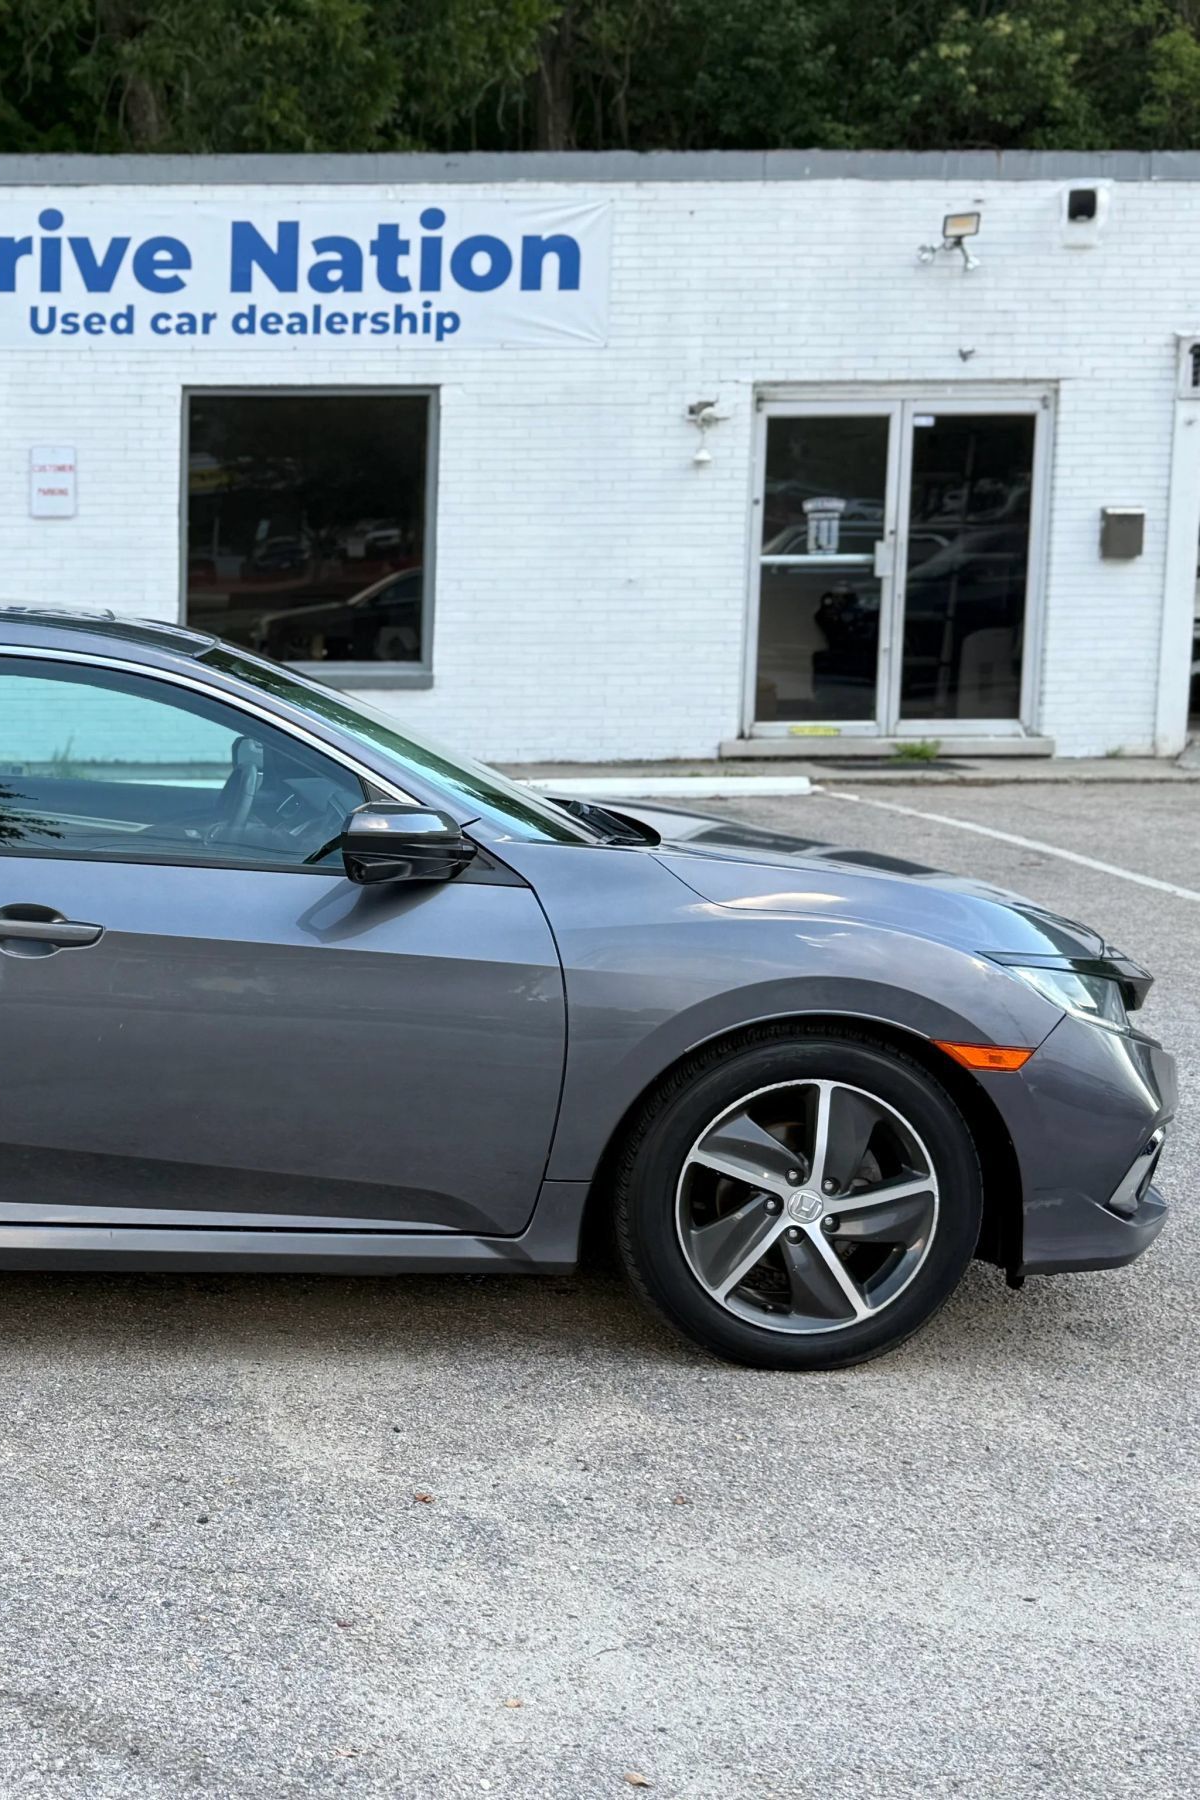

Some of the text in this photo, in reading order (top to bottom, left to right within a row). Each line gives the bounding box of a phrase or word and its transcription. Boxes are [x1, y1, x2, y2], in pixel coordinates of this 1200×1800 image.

[230, 207, 582, 295] Nation
[29, 301, 462, 343] Used car dealership
